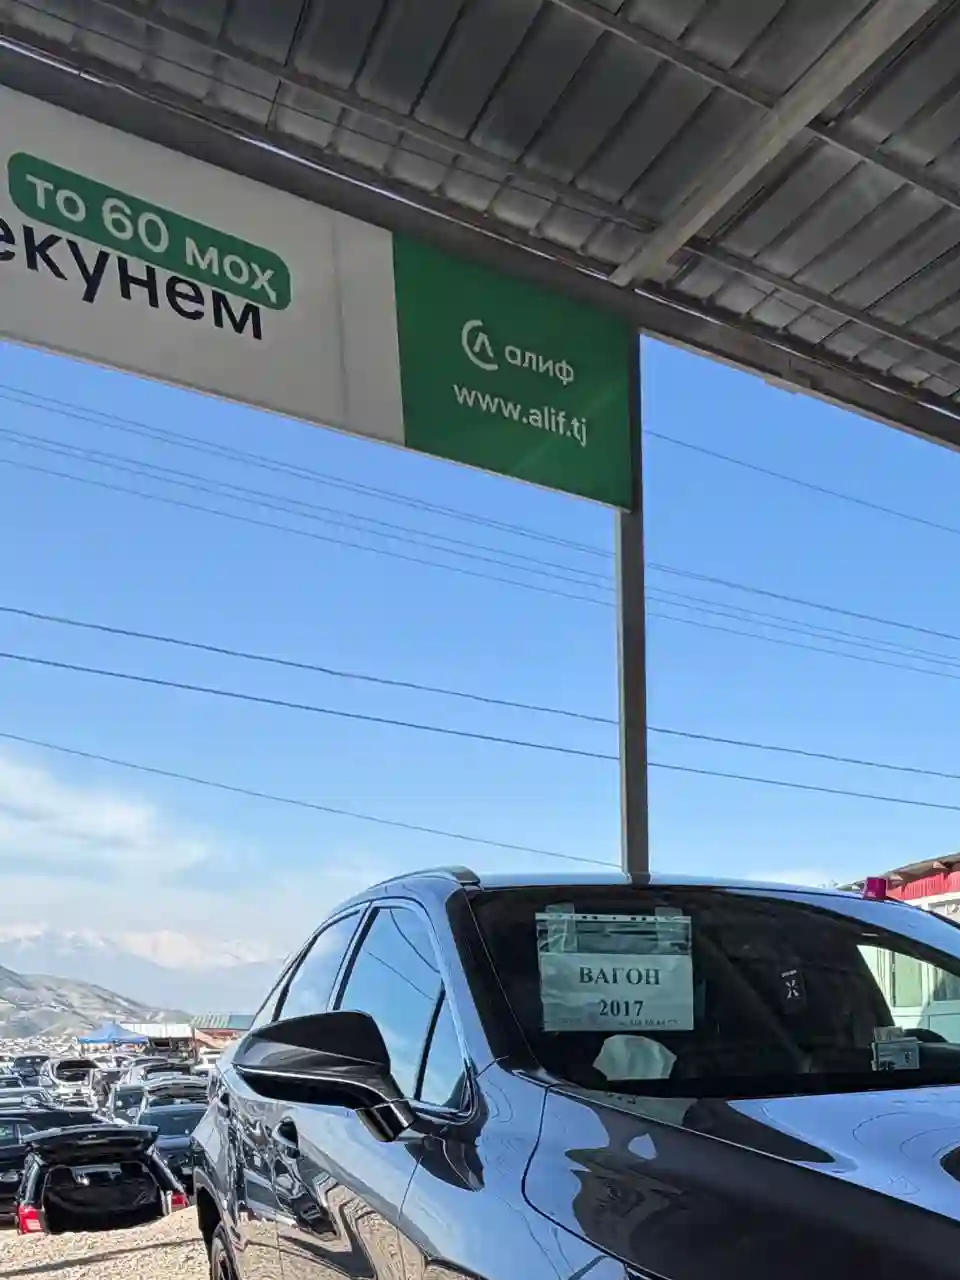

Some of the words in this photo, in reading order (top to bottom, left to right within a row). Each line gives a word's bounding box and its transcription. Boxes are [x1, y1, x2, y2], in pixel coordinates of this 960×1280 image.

[101, 197, 169, 253] 60
[504, 345, 574, 385] алиф
[452, 384, 587, 447] www.alif.tj
[579, 965, 661, 985] ВАГОН
[599, 1000, 644, 1016] 2017
